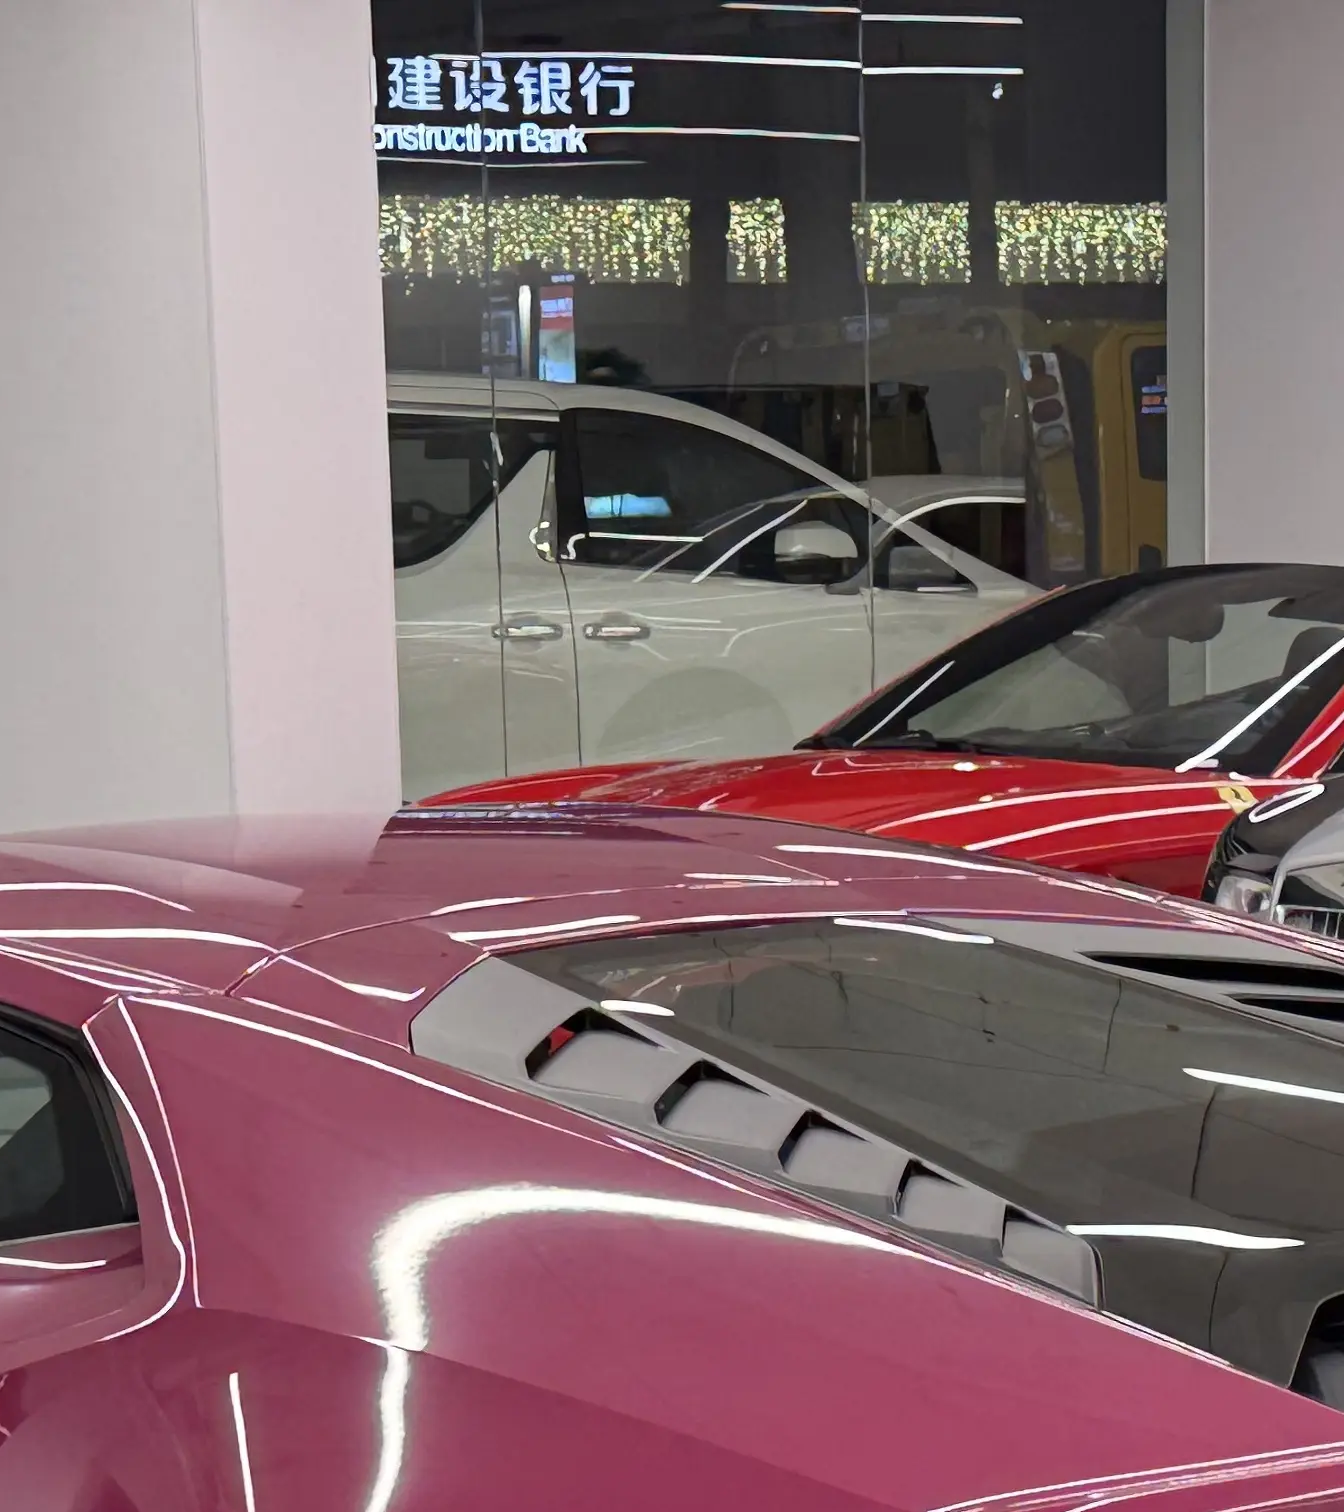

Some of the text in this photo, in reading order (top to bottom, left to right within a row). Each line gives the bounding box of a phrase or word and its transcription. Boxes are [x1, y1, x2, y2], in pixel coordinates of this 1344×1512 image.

[372, 55, 635, 116] 建设银行
[518, 122, 588, 153] Bank
